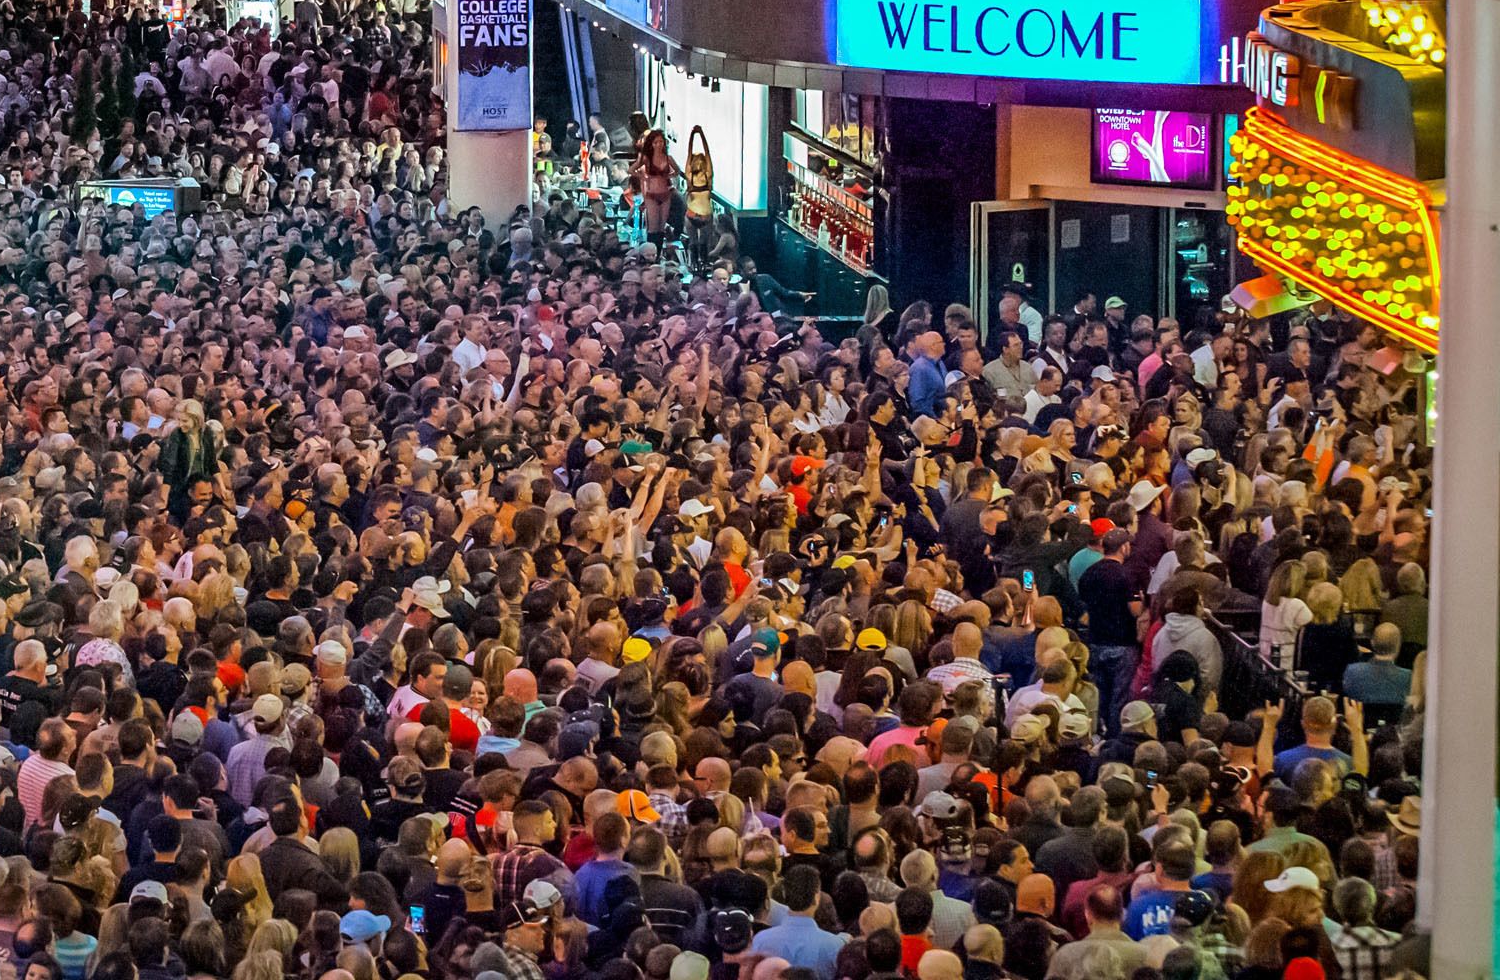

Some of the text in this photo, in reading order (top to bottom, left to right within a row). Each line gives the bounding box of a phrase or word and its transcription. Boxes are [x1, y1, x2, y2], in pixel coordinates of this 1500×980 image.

[459, 0, 527, 14] COLLEGE
[460, 14, 527, 25] BASKETBALL
[460, 25, 528, 47] FANS
[877, 0, 1140, 62] WELCOME
[482, 107, 508, 116] HOST
[1100, 115, 1142, 125] DOWNTOWN
[1111, 123, 1131, 131] HOTEL
